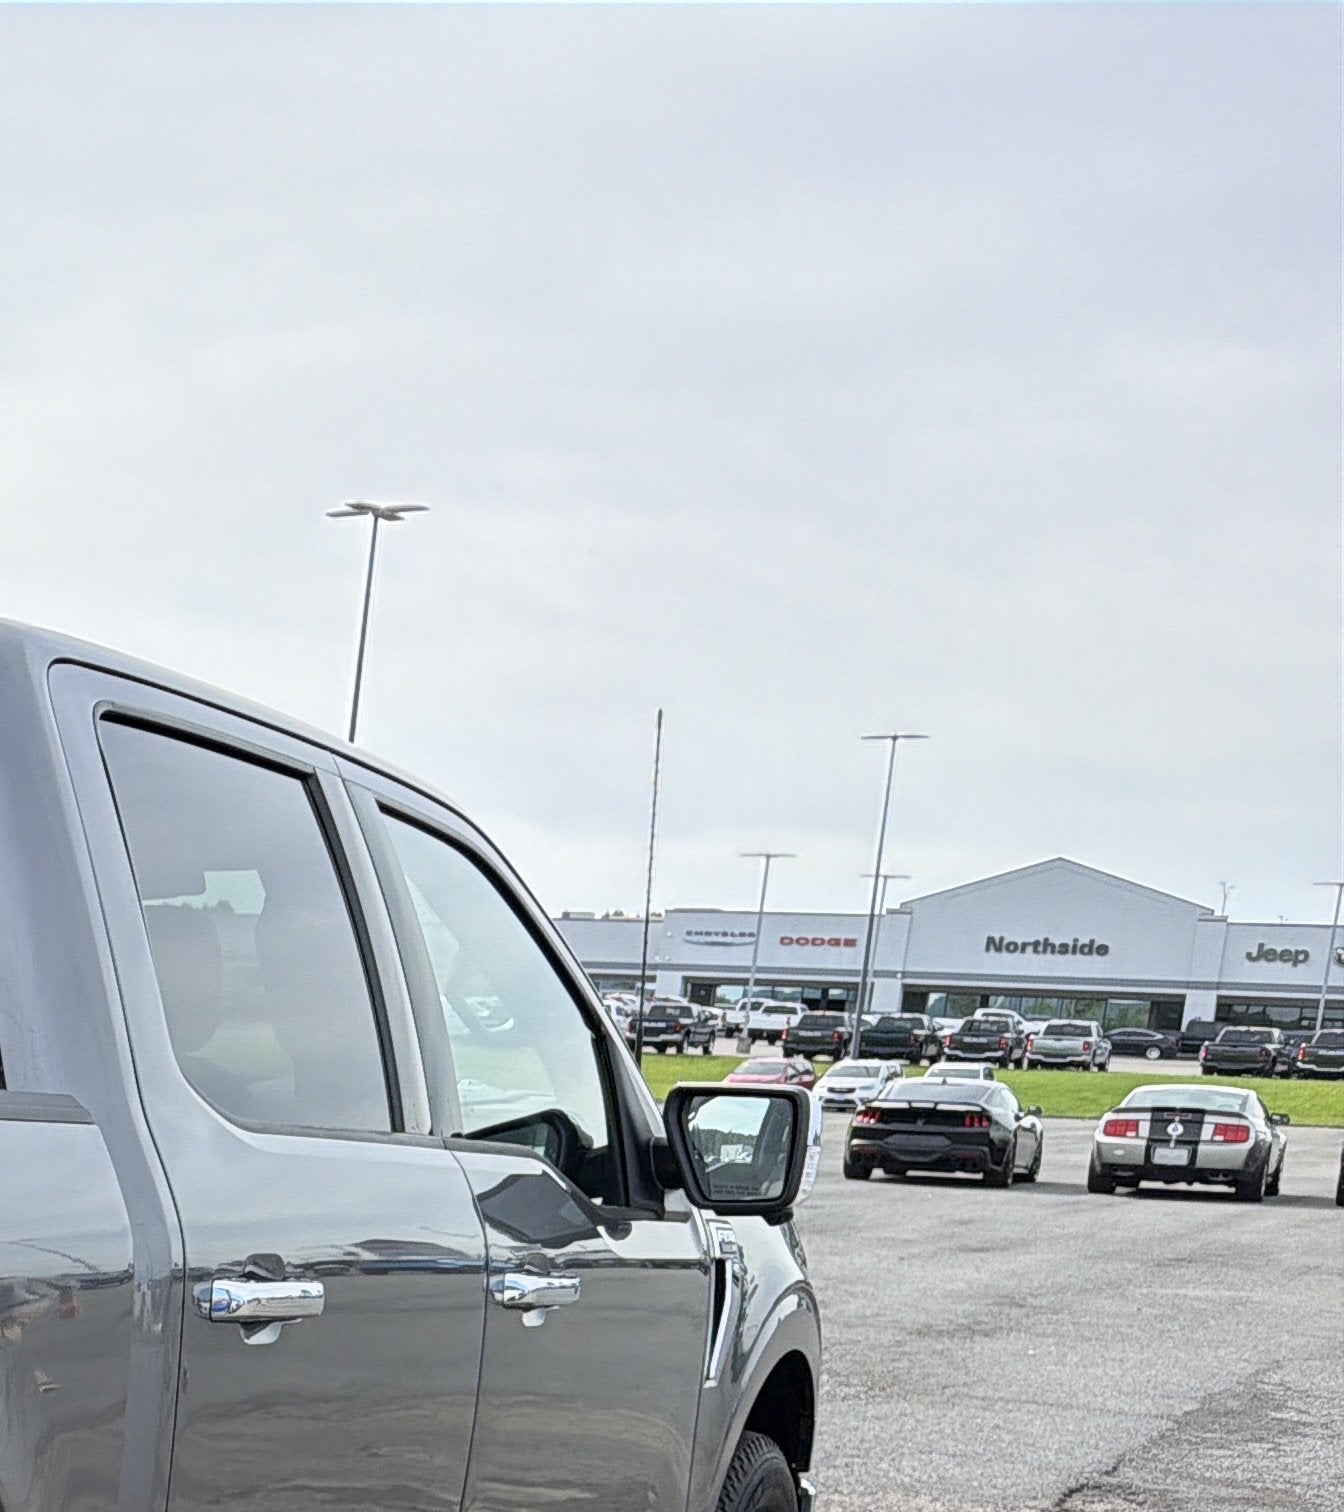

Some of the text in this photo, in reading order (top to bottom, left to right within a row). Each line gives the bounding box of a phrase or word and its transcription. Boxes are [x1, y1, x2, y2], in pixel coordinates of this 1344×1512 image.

[779, 935, 858, 948] DODGE
[985, 935, 1110, 957] Northside
[1245, 942, 1310, 968] Jeep
